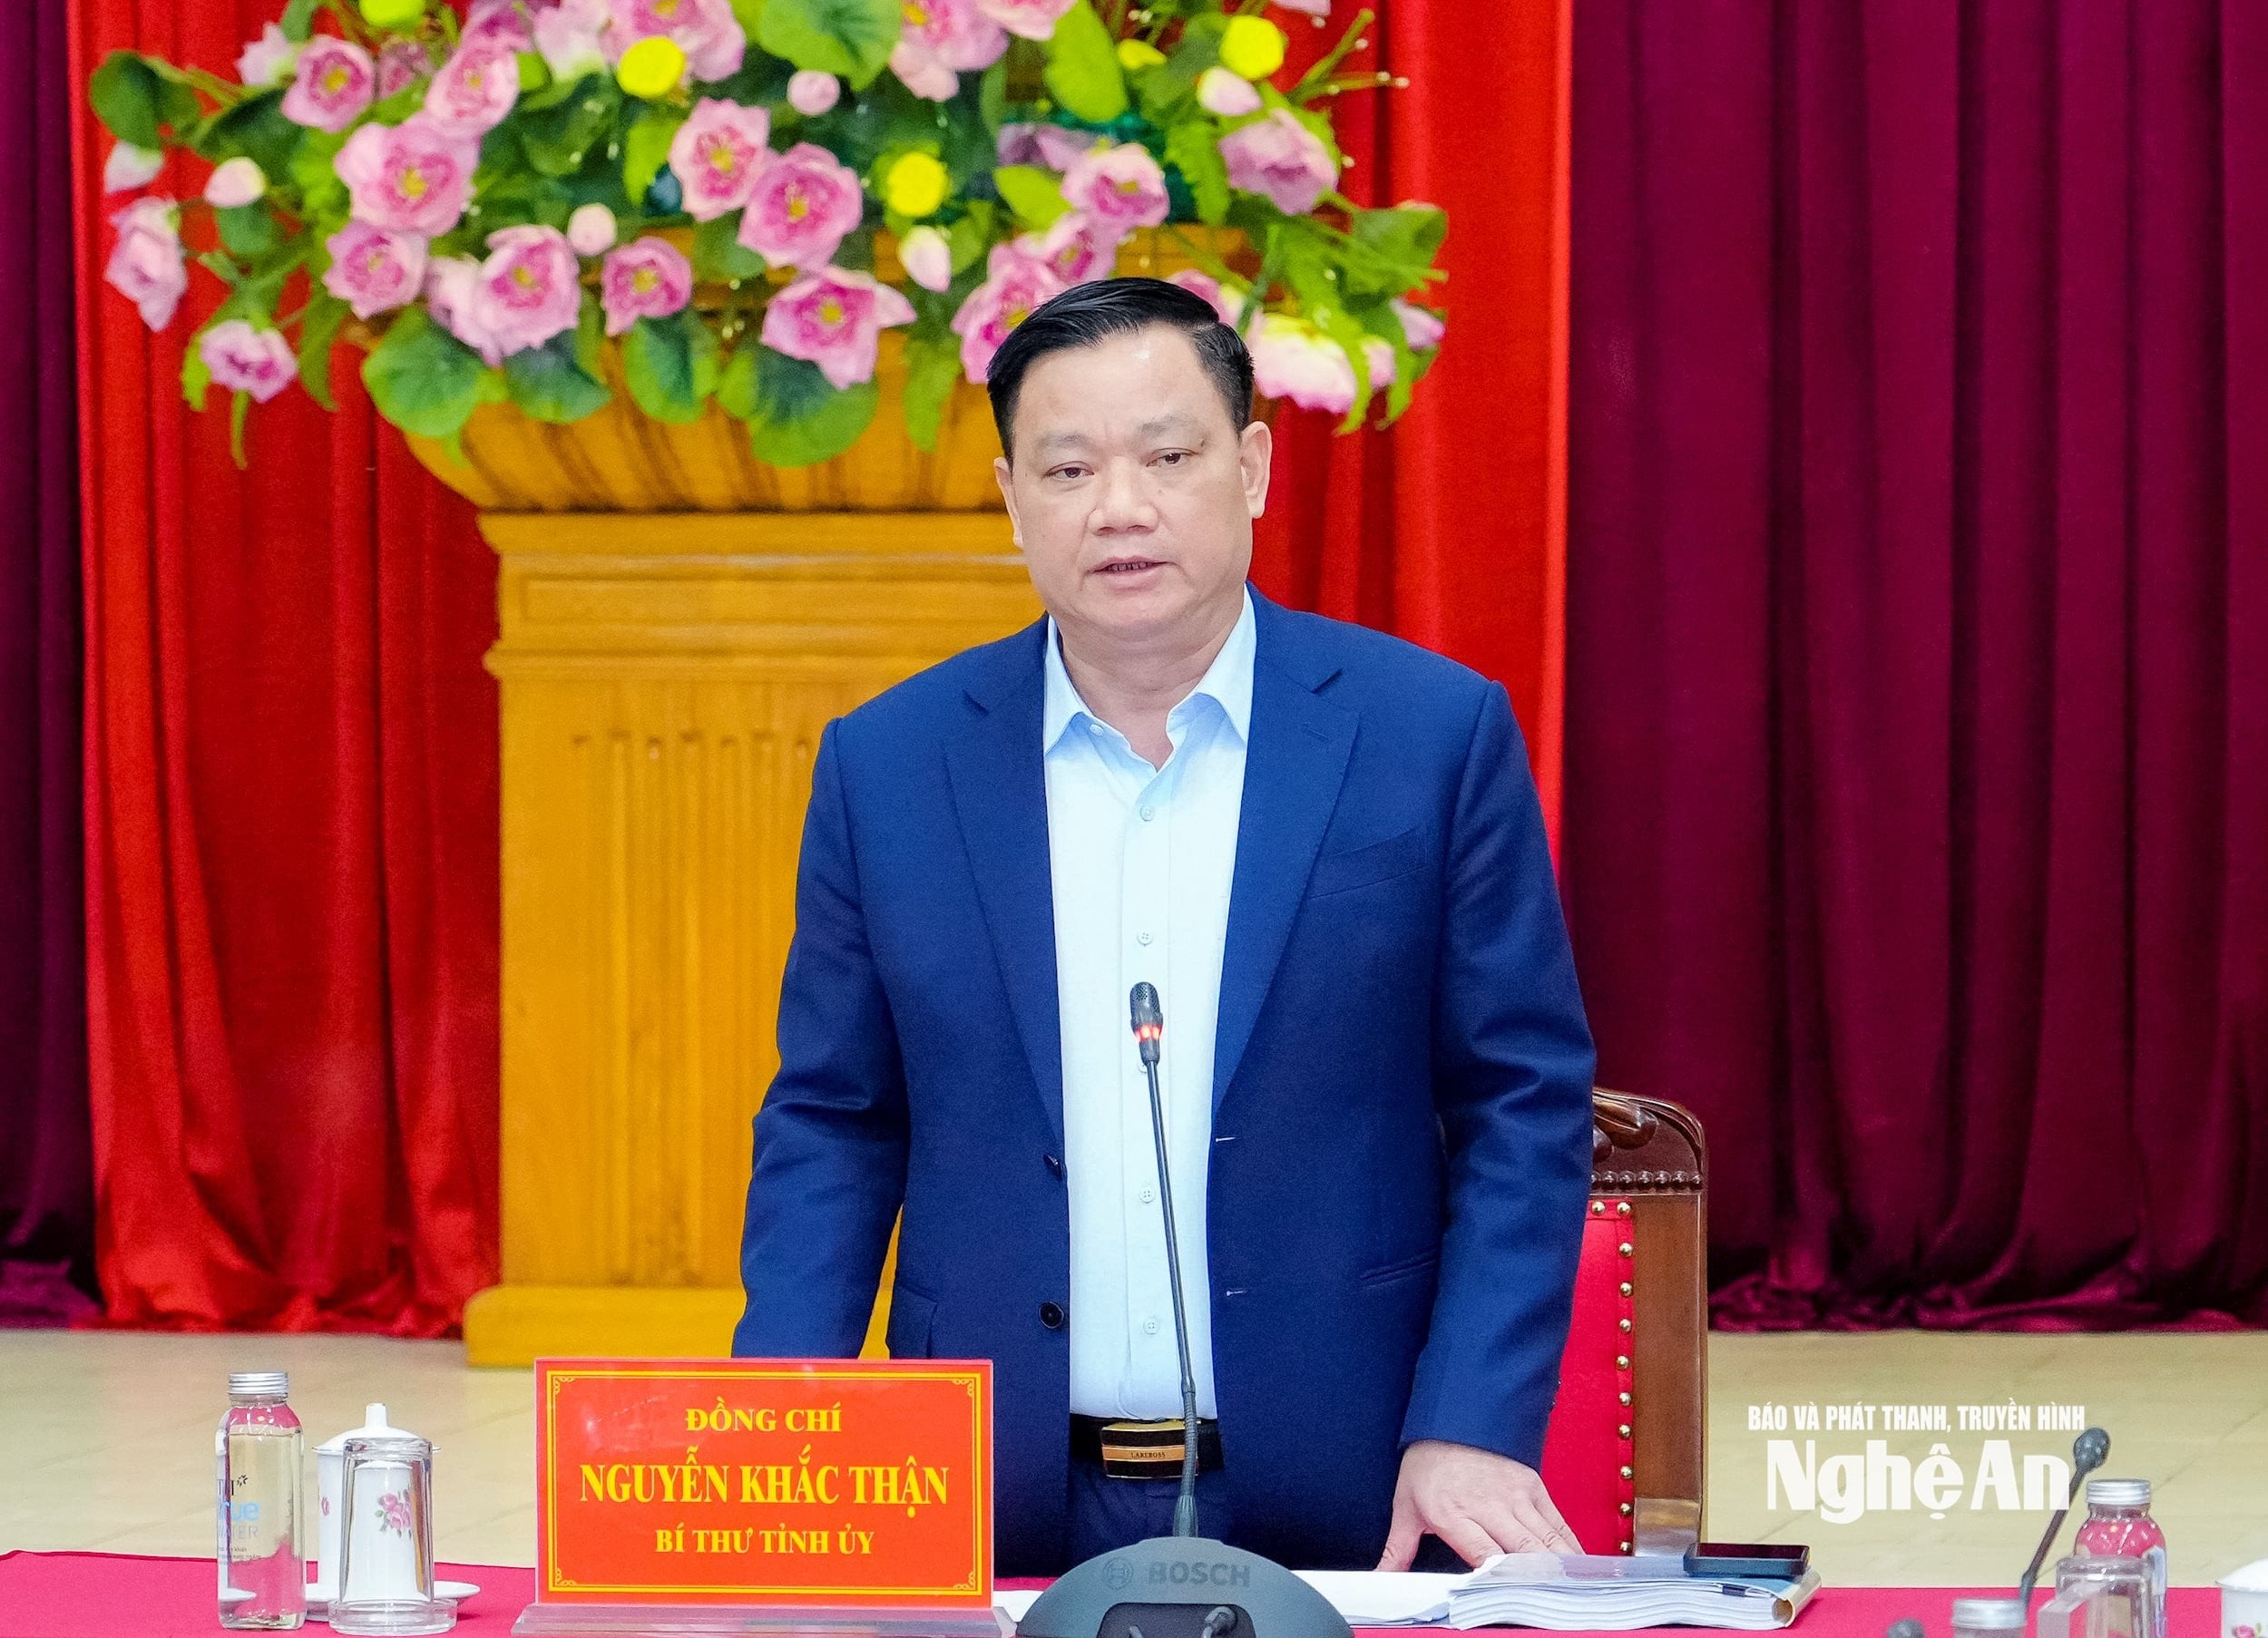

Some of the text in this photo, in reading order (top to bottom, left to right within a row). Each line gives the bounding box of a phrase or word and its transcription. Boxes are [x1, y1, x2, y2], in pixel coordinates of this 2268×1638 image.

[685, 1396, 842, 1432] ĐỒNG CHÍ
[580, 1444, 949, 1517] NGUYỄN KHẮC THẬN
[656, 1523, 874, 1554] BÍ THƯ TỈNH ỦY
[1149, 1561, 1251, 1588] BOSCH
